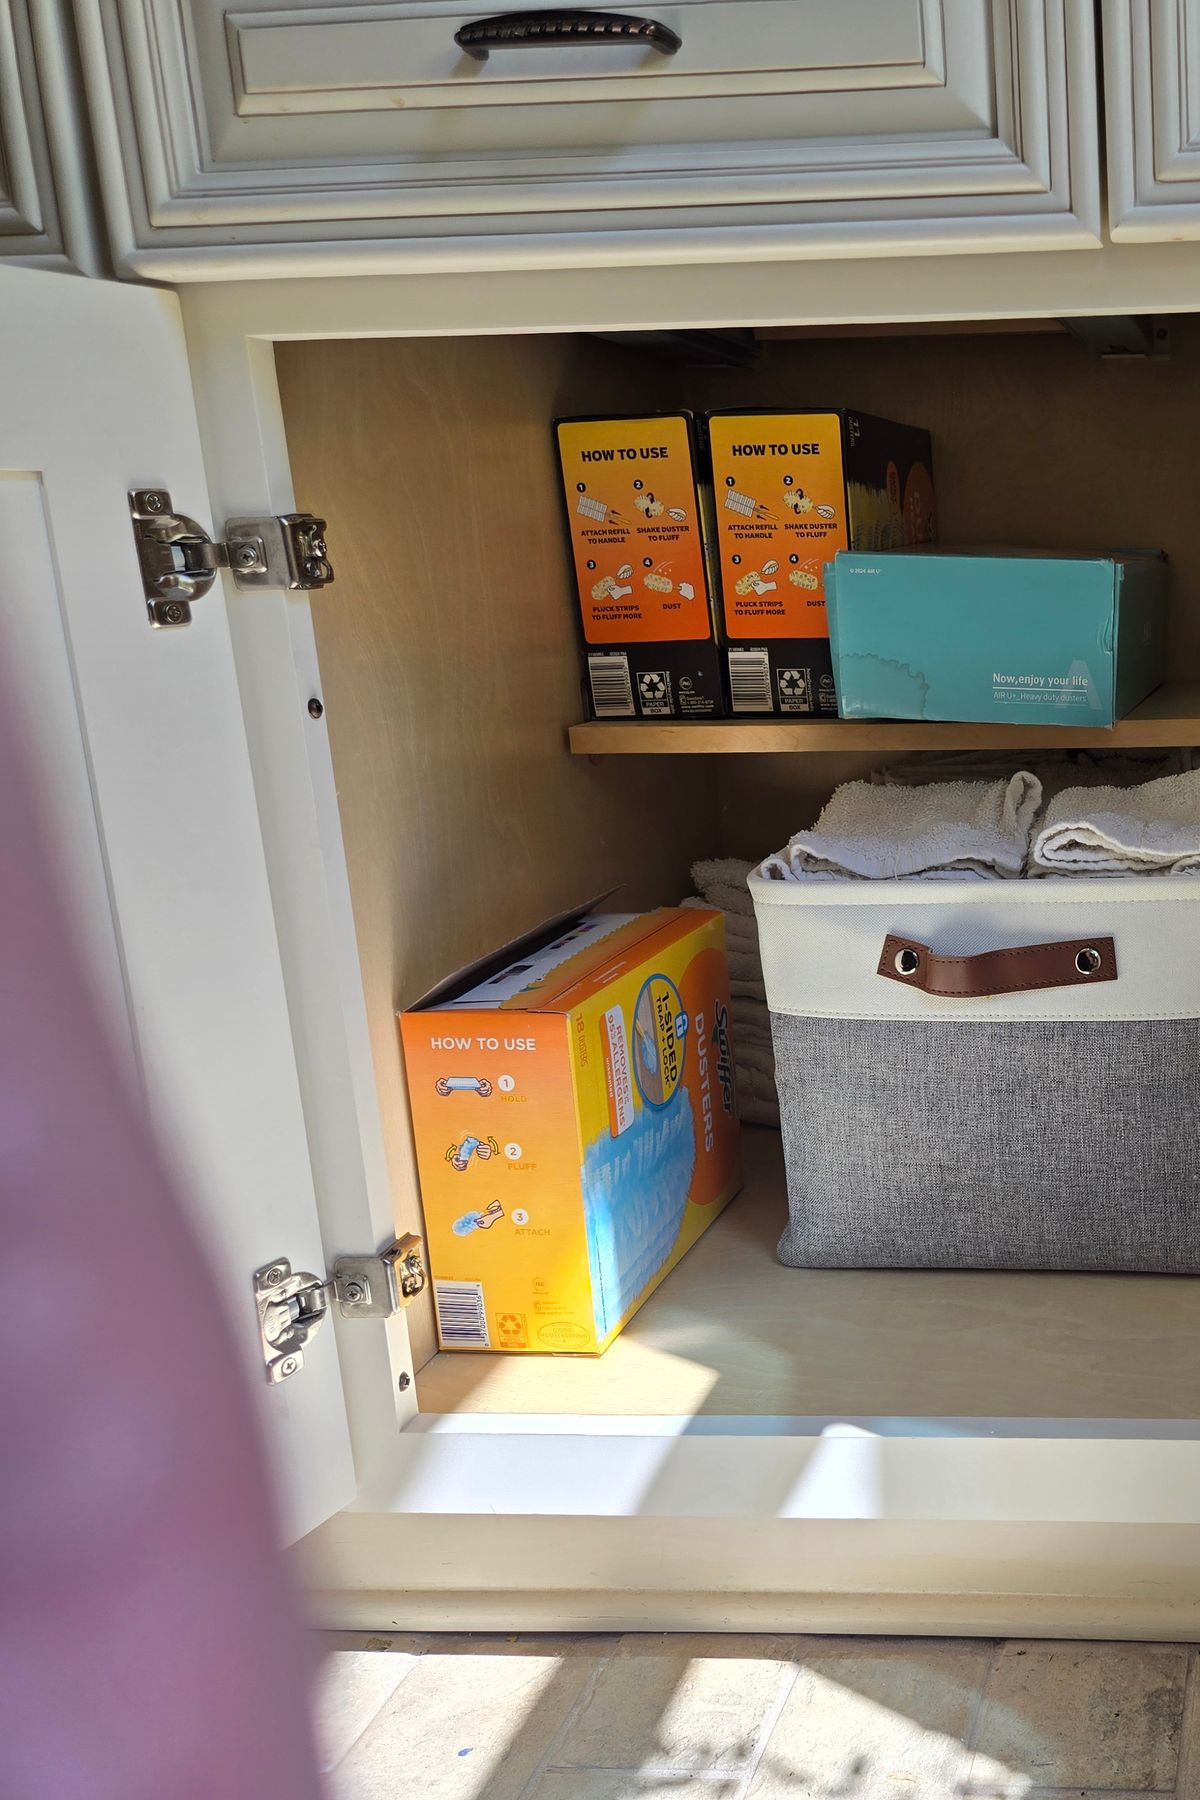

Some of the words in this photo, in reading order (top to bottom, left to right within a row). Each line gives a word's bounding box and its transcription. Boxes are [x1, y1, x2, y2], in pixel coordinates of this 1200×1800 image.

[581, 450, 614, 462] HOW
[618, 448, 636, 460] TO
[640, 447, 668, 459] USE
[732, 444, 766, 456] HOW
[769, 444, 788, 456] TO
[792, 444, 820, 455] USE
[581, 528, 608, 536] ATTACH
[636, 526, 661, 534] SHAKE
[993, 673, 1044, 687] Now,enjoy
[1048, 677, 1069, 687] your
[1072, 676, 1088, 686] life
[1043, 694, 1060, 702] duty
[1061, 694, 1087, 702] dusters
[656, 994, 665, 1032] TRAP
[575, 1013, 584, 1032] 18
[431, 1037, 472, 1050] HOW
[476, 1038, 499, 1050] TO
[504, 1038, 536, 1051] USE
[579, 1034, 588, 1067] DUSTERS
[616, 1025, 629, 1094] REMOVES
[714, 998, 732, 1115] Swiffer
[695, 1012, 714, 1153] DUSTERS
[514, 1228, 550, 1236] ATTACH
